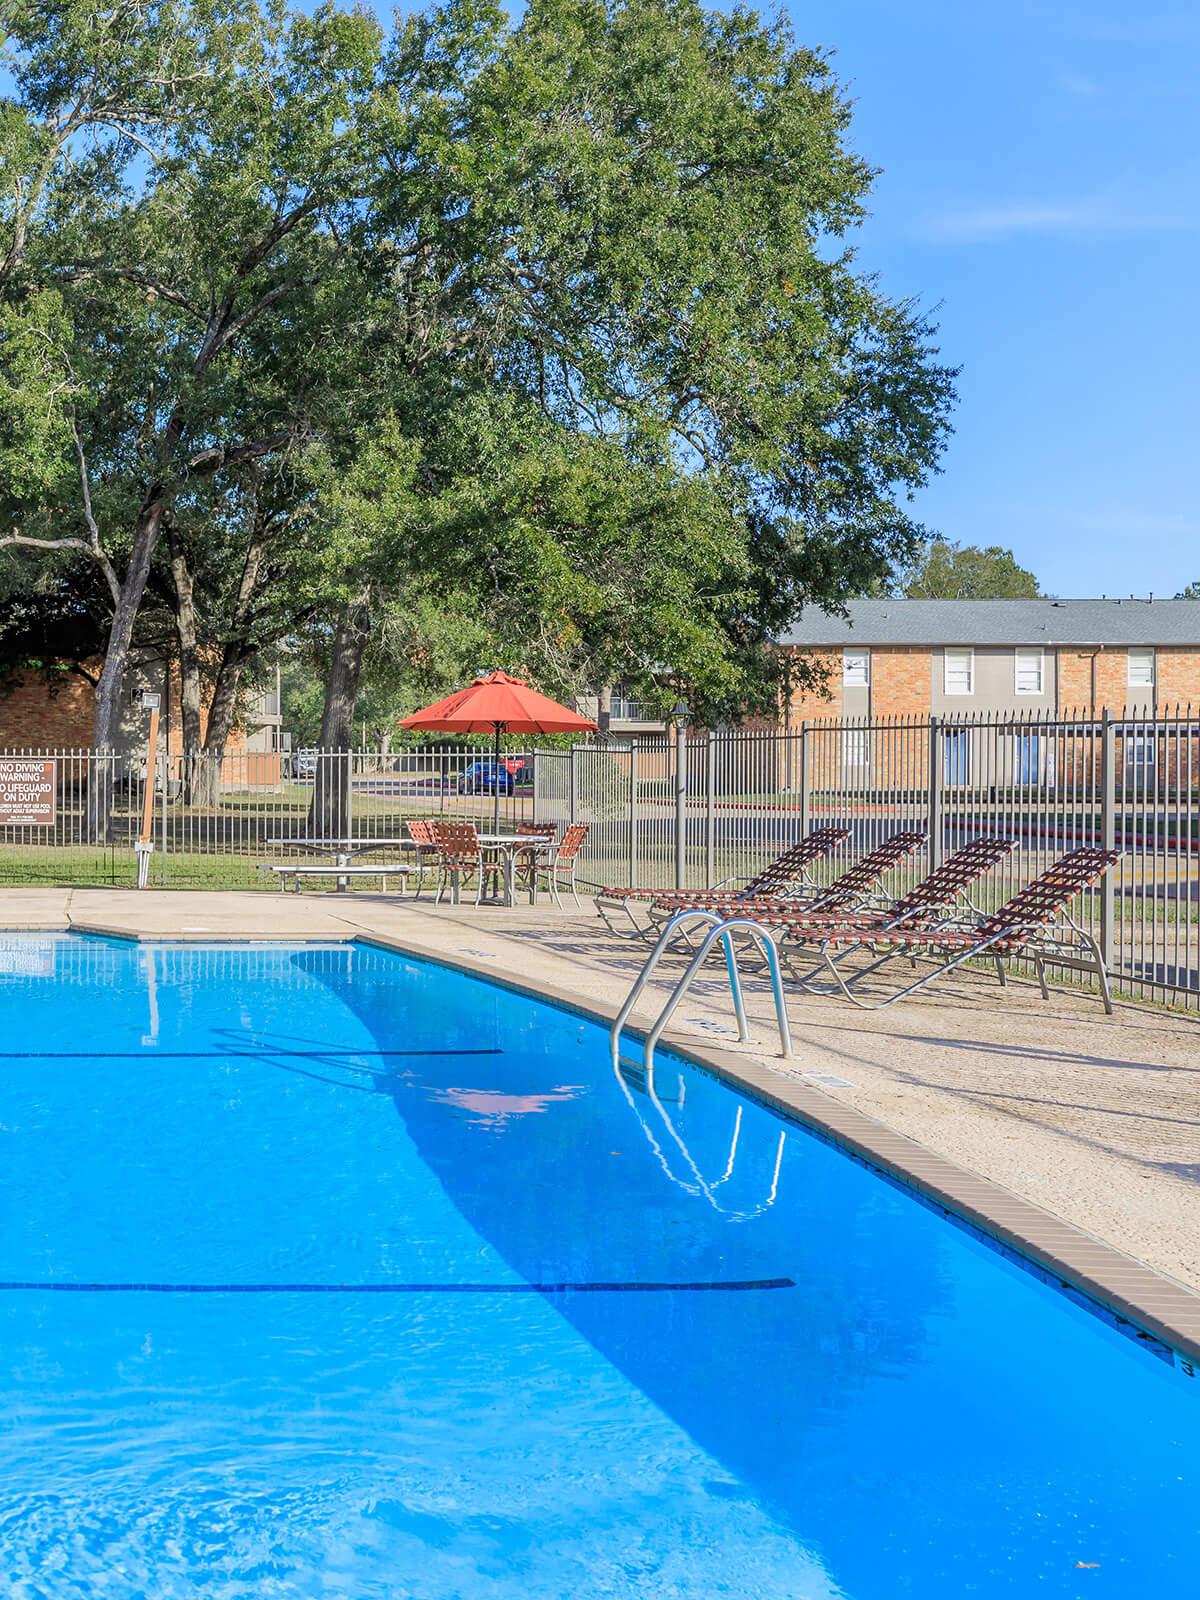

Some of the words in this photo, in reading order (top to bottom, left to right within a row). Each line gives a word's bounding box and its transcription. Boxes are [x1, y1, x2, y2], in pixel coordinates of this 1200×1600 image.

[0, 763, 13, 772] NO
[15, 763, 44, 772] DIVING
[0, 773, 40, 782] WARNING
[7, 783, 51, 792] LIFEGUARD
[3, 793, 17, 802] ON
[18, 793, 41, 802] DUTY
